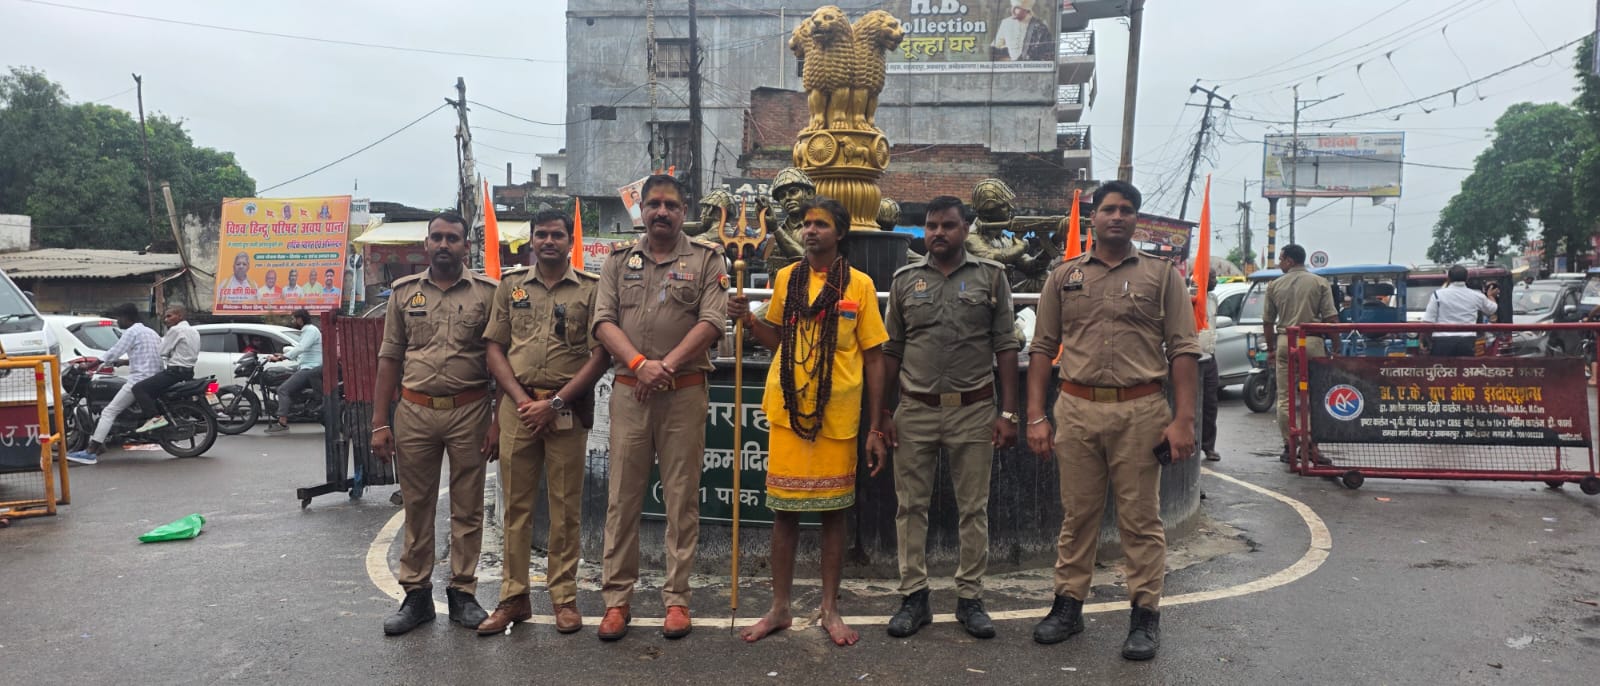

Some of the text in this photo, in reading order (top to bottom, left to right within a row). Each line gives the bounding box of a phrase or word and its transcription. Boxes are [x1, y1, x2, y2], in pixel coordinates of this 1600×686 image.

[900, 18, 987, 33] ollection
[900, 36, 976, 59] दूल्हा घर
[226, 221, 247, 234] विश्व
[250, 221, 269, 239] हिन्दू
[272, 221, 297, 234] परिषद
[301, 222, 321, 233] अवध
[1314, 255, 1325, 264] 30
[1425, 363, 1457, 381] पुलिस
[1451, 383, 1476, 401] ऑफ
[715, 487, 760, 506] पाक
